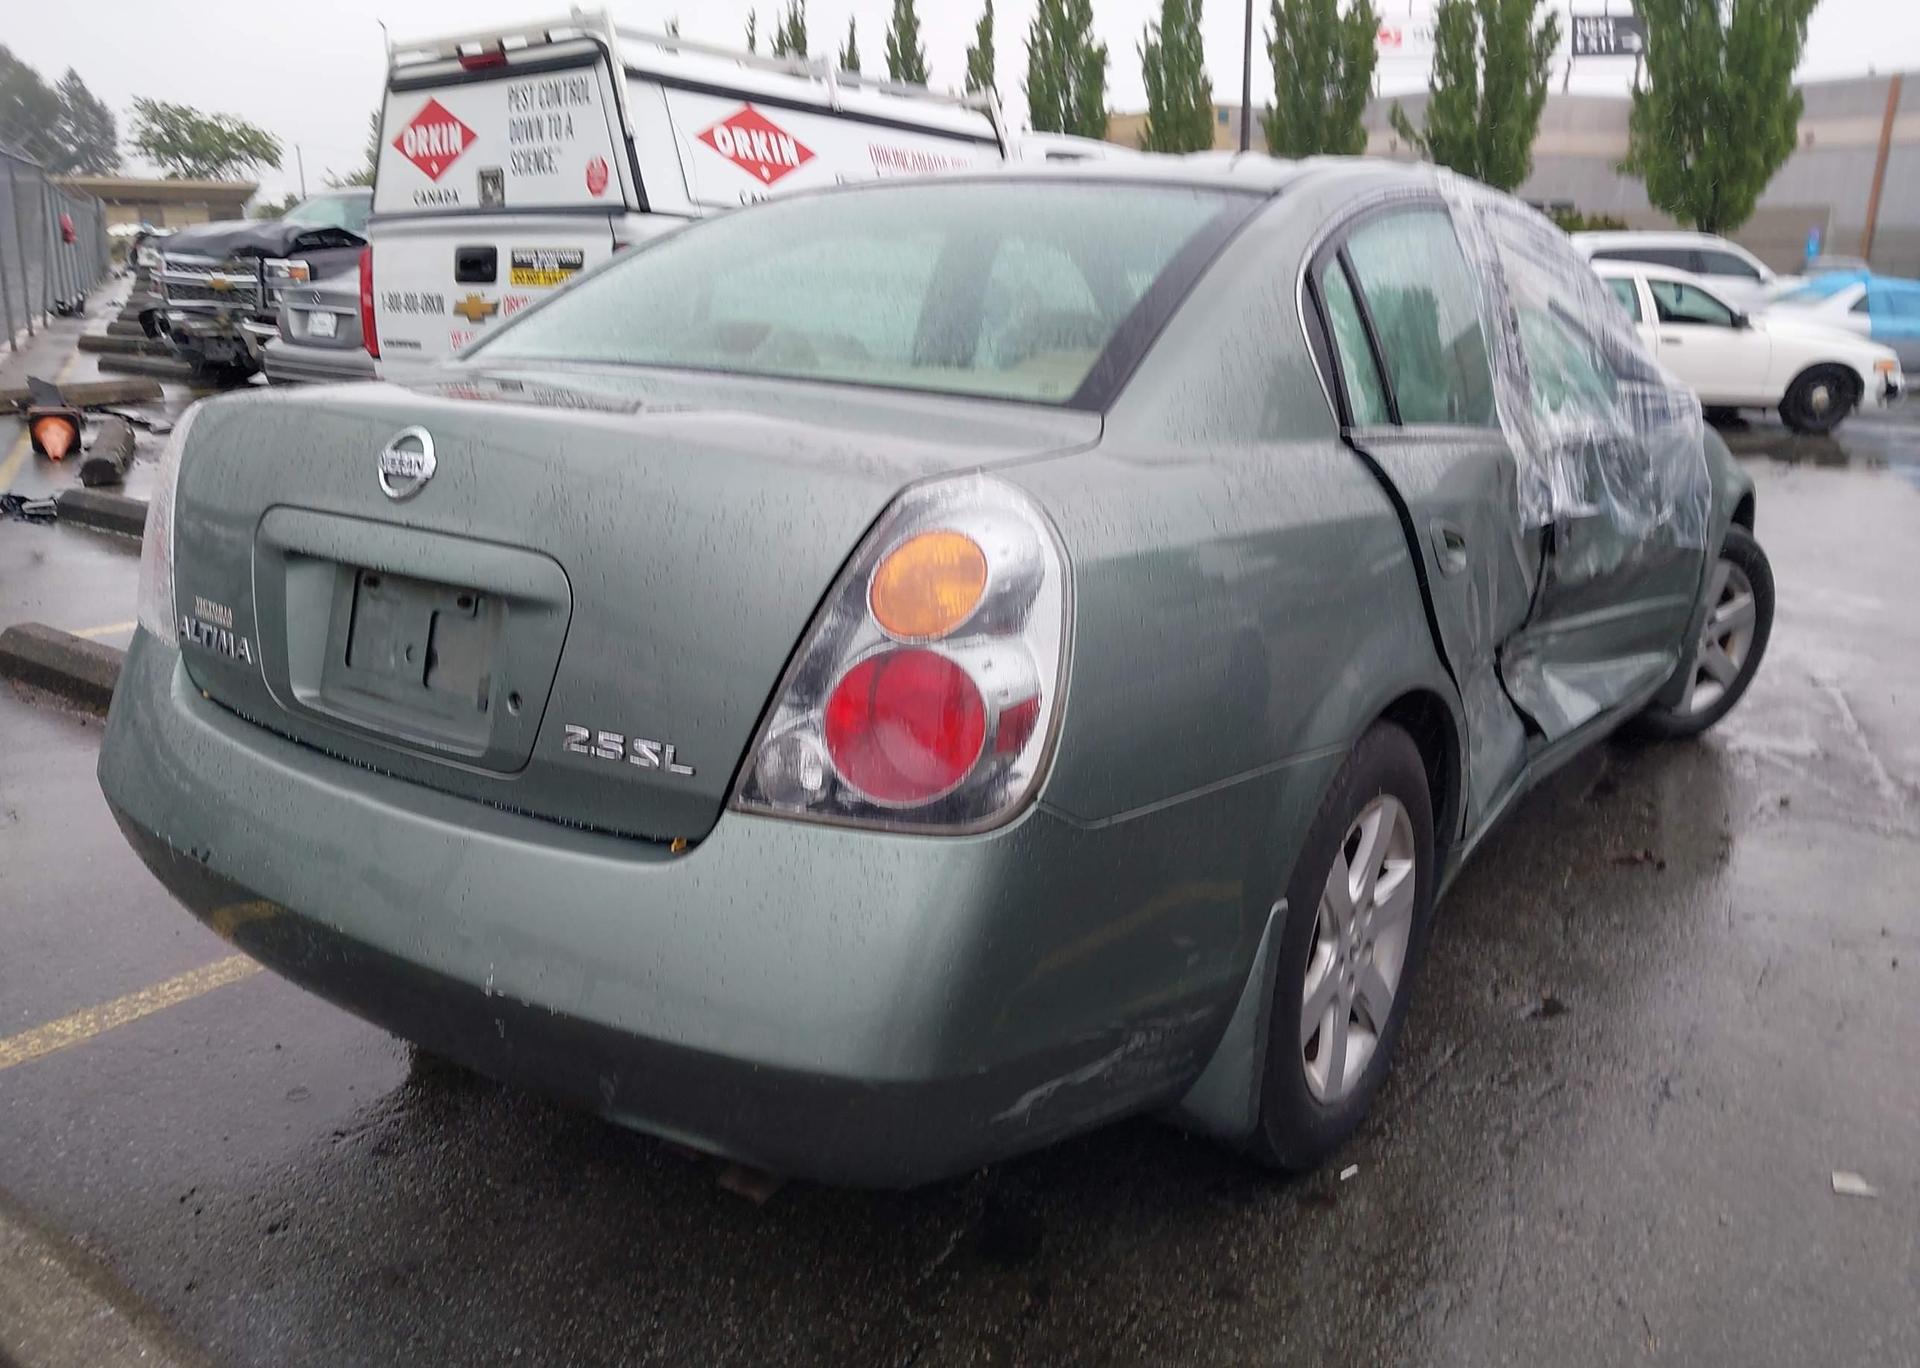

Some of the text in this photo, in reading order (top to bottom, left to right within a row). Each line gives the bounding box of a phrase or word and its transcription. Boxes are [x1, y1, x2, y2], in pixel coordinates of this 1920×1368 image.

[508, 76, 591, 113] PEST CONTROL
[402, 121, 464, 160] ORKIN
[509, 110, 575, 144] DOWN TO A
[711, 123, 802, 168] ORKIN
[413, 187, 462, 207] CANADA
[180, 614, 256, 665] ALTIMA
[563, 723, 696, 775] 2.5 SL
